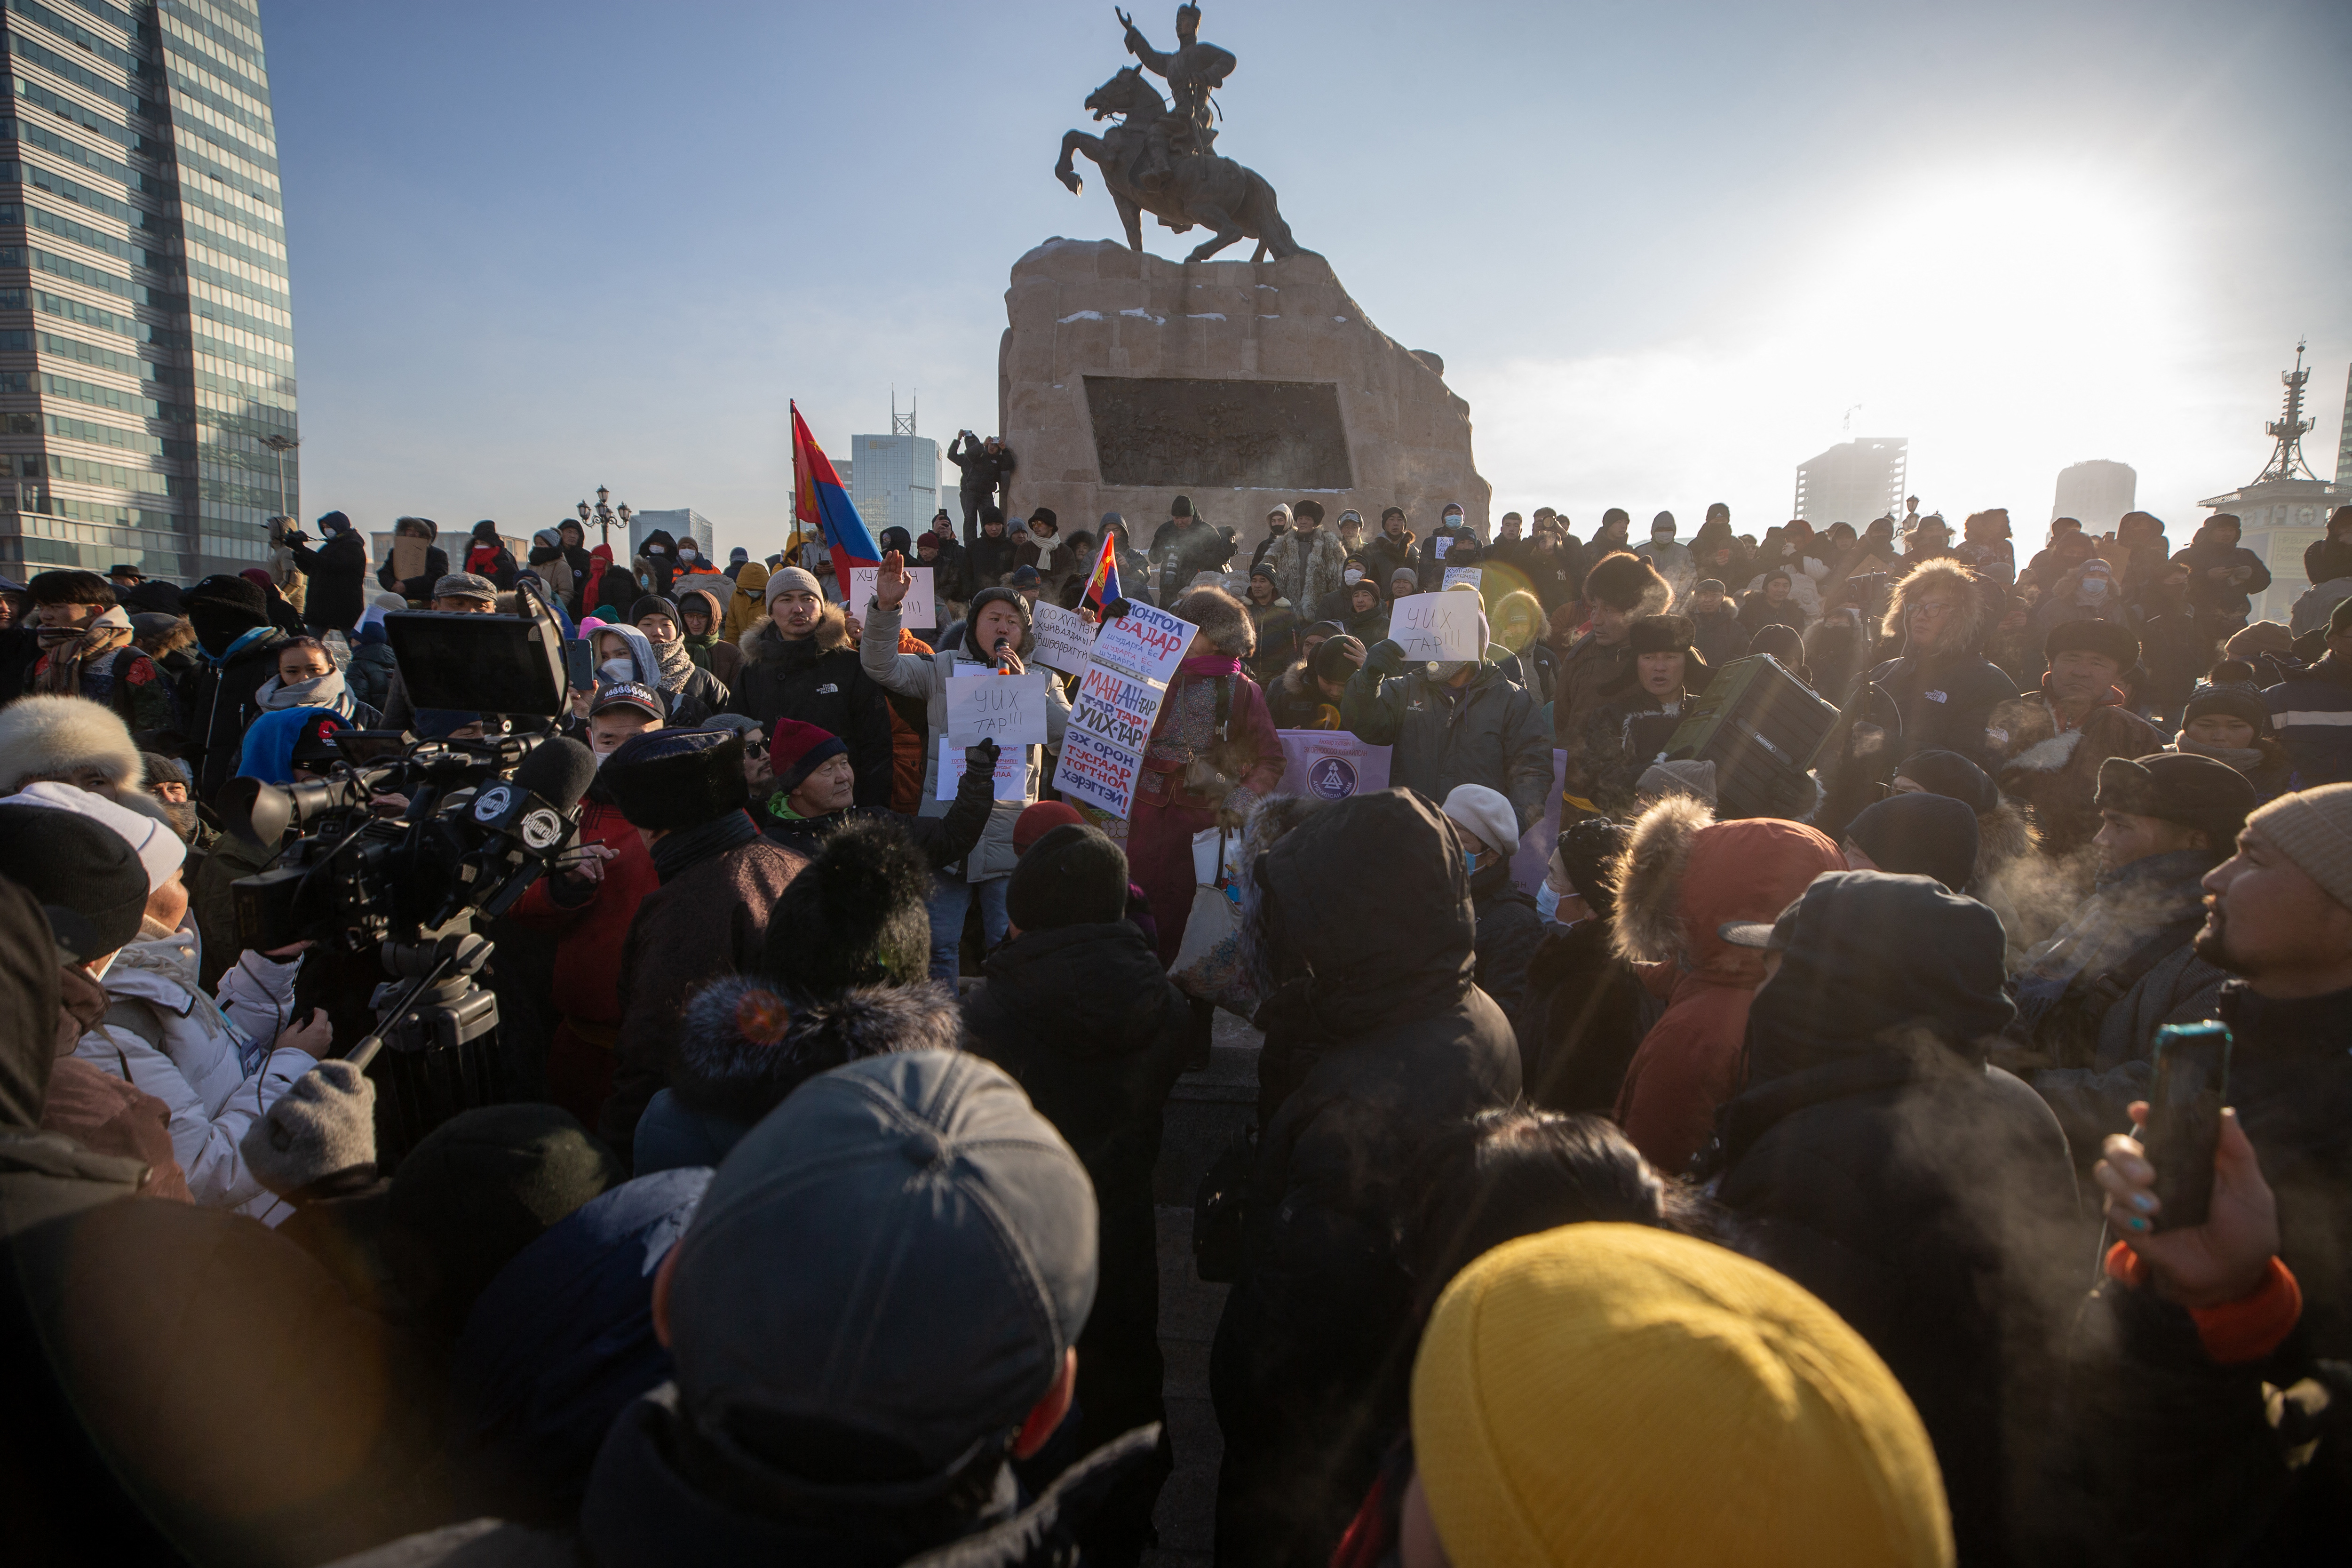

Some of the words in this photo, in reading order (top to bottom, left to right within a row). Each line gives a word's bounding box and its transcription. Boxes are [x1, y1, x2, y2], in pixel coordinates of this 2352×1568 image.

[1557, 569, 1566, 581] NY
[1040, 608, 1057, 620] 100
[1106, 634, 1143, 652] ШУДАРГА
[1114, 617, 1181, 661] БАДАР
[1099, 650, 1135, 669] ШУДАРГА
[1102, 643, 1136, 660] ШУДАРГА
[1985, 727, 2003, 736] NORTH
[1068, 732, 1091, 747] ЭХ
[1094, 742, 1134, 768] ОРОН
[1756, 734, 1773, 750] REMAX
[1068, 744, 1131, 780] ТУСГААР
[1065, 756, 1129, 794] ТОГТНОЛ
[1313, 780, 1342, 798] АРДЧИЛСАН
[1343, 782, 1352, 794] НАМ
[521, 812, 563, 845] paparazzi
